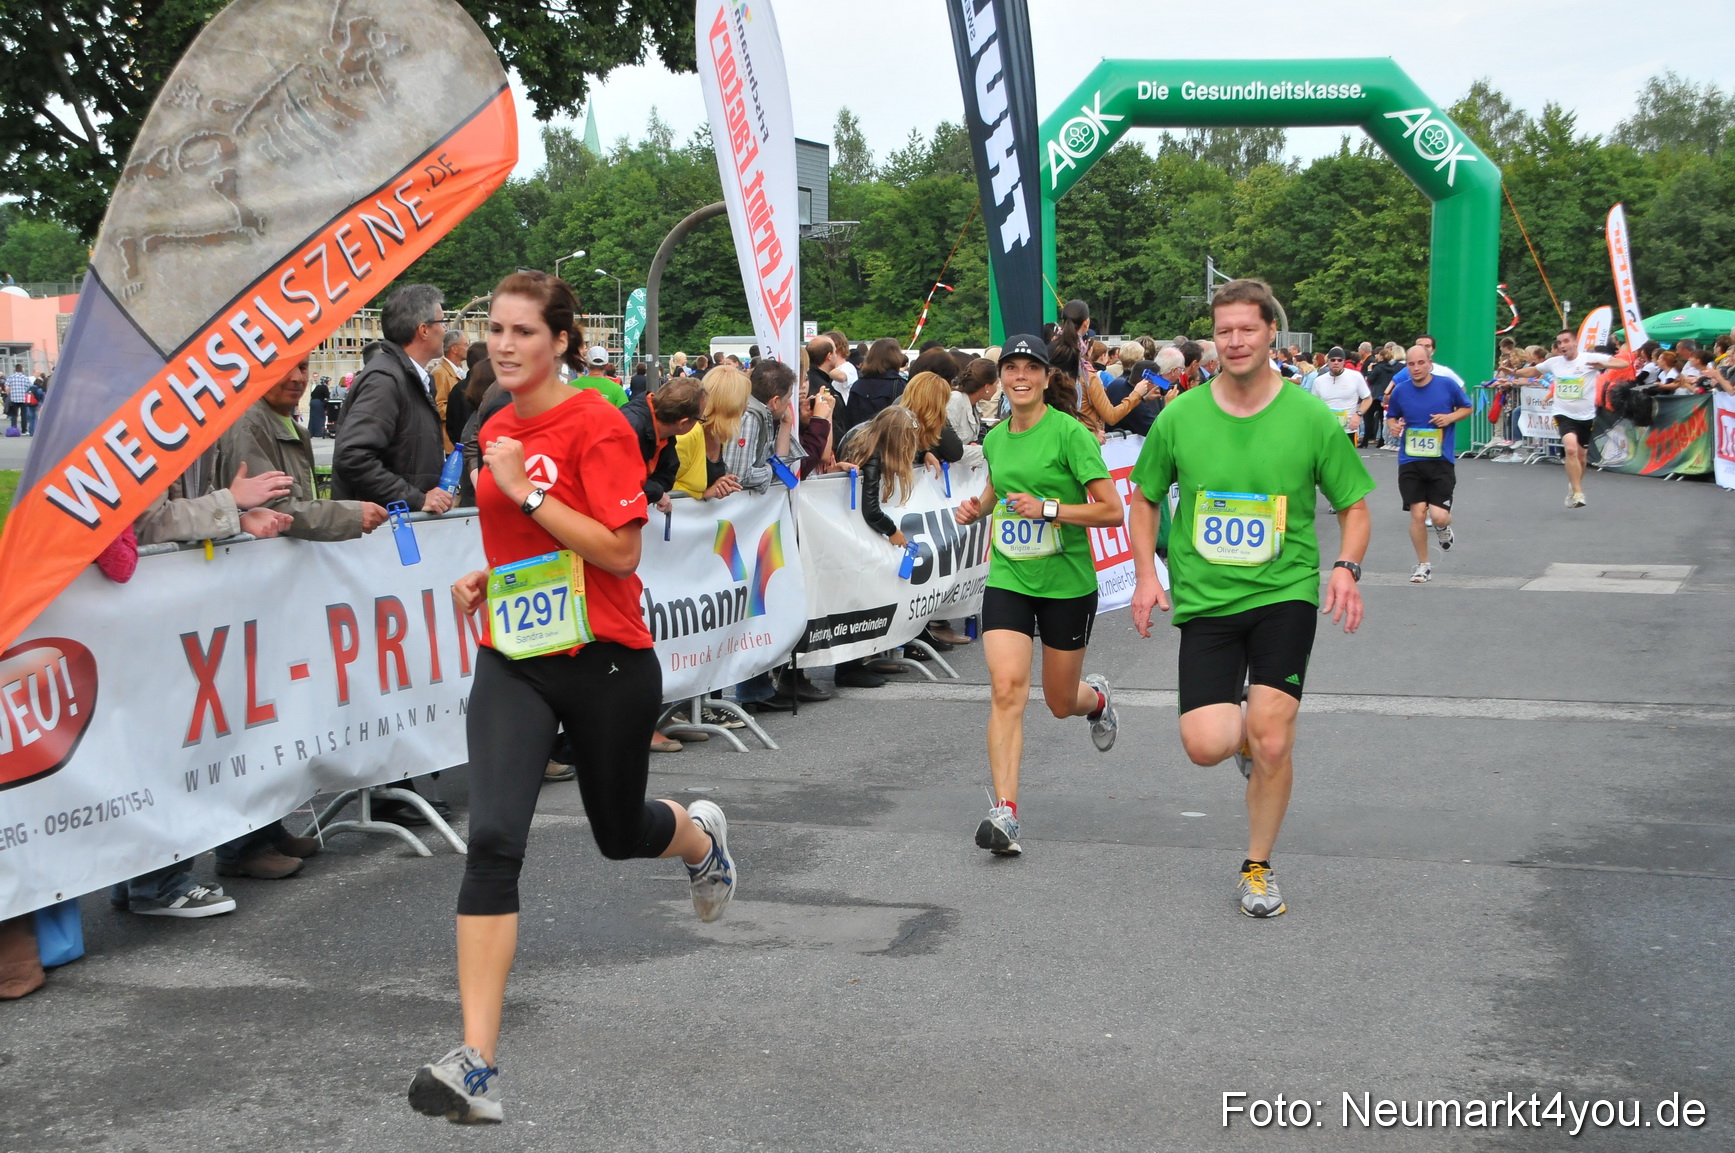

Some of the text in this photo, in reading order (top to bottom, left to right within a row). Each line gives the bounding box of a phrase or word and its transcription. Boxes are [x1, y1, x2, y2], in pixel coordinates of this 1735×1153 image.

[1137, 80, 1367, 101] Die Gesundheitskasse.
[1046, 90, 1125, 190] AOK
[1382, 107, 1478, 187] AOK
[1557, 385, 1579, 393] 1212
[1411, 437, 1435, 449] 145
[1001, 520, 1046, 544] 807
[1203, 516, 1265, 548] 809
[1216, 546, 1239, 554] Oliver
[496, 586, 568, 634] 1297
[516, 631, 544, 644] Sandra
[834, 622, 847, 638] die
[850, 617, 887, 635] verbinden
[671, 645, 712, 671] Druck
[45, 788, 154, 836] 09621/6715-0
